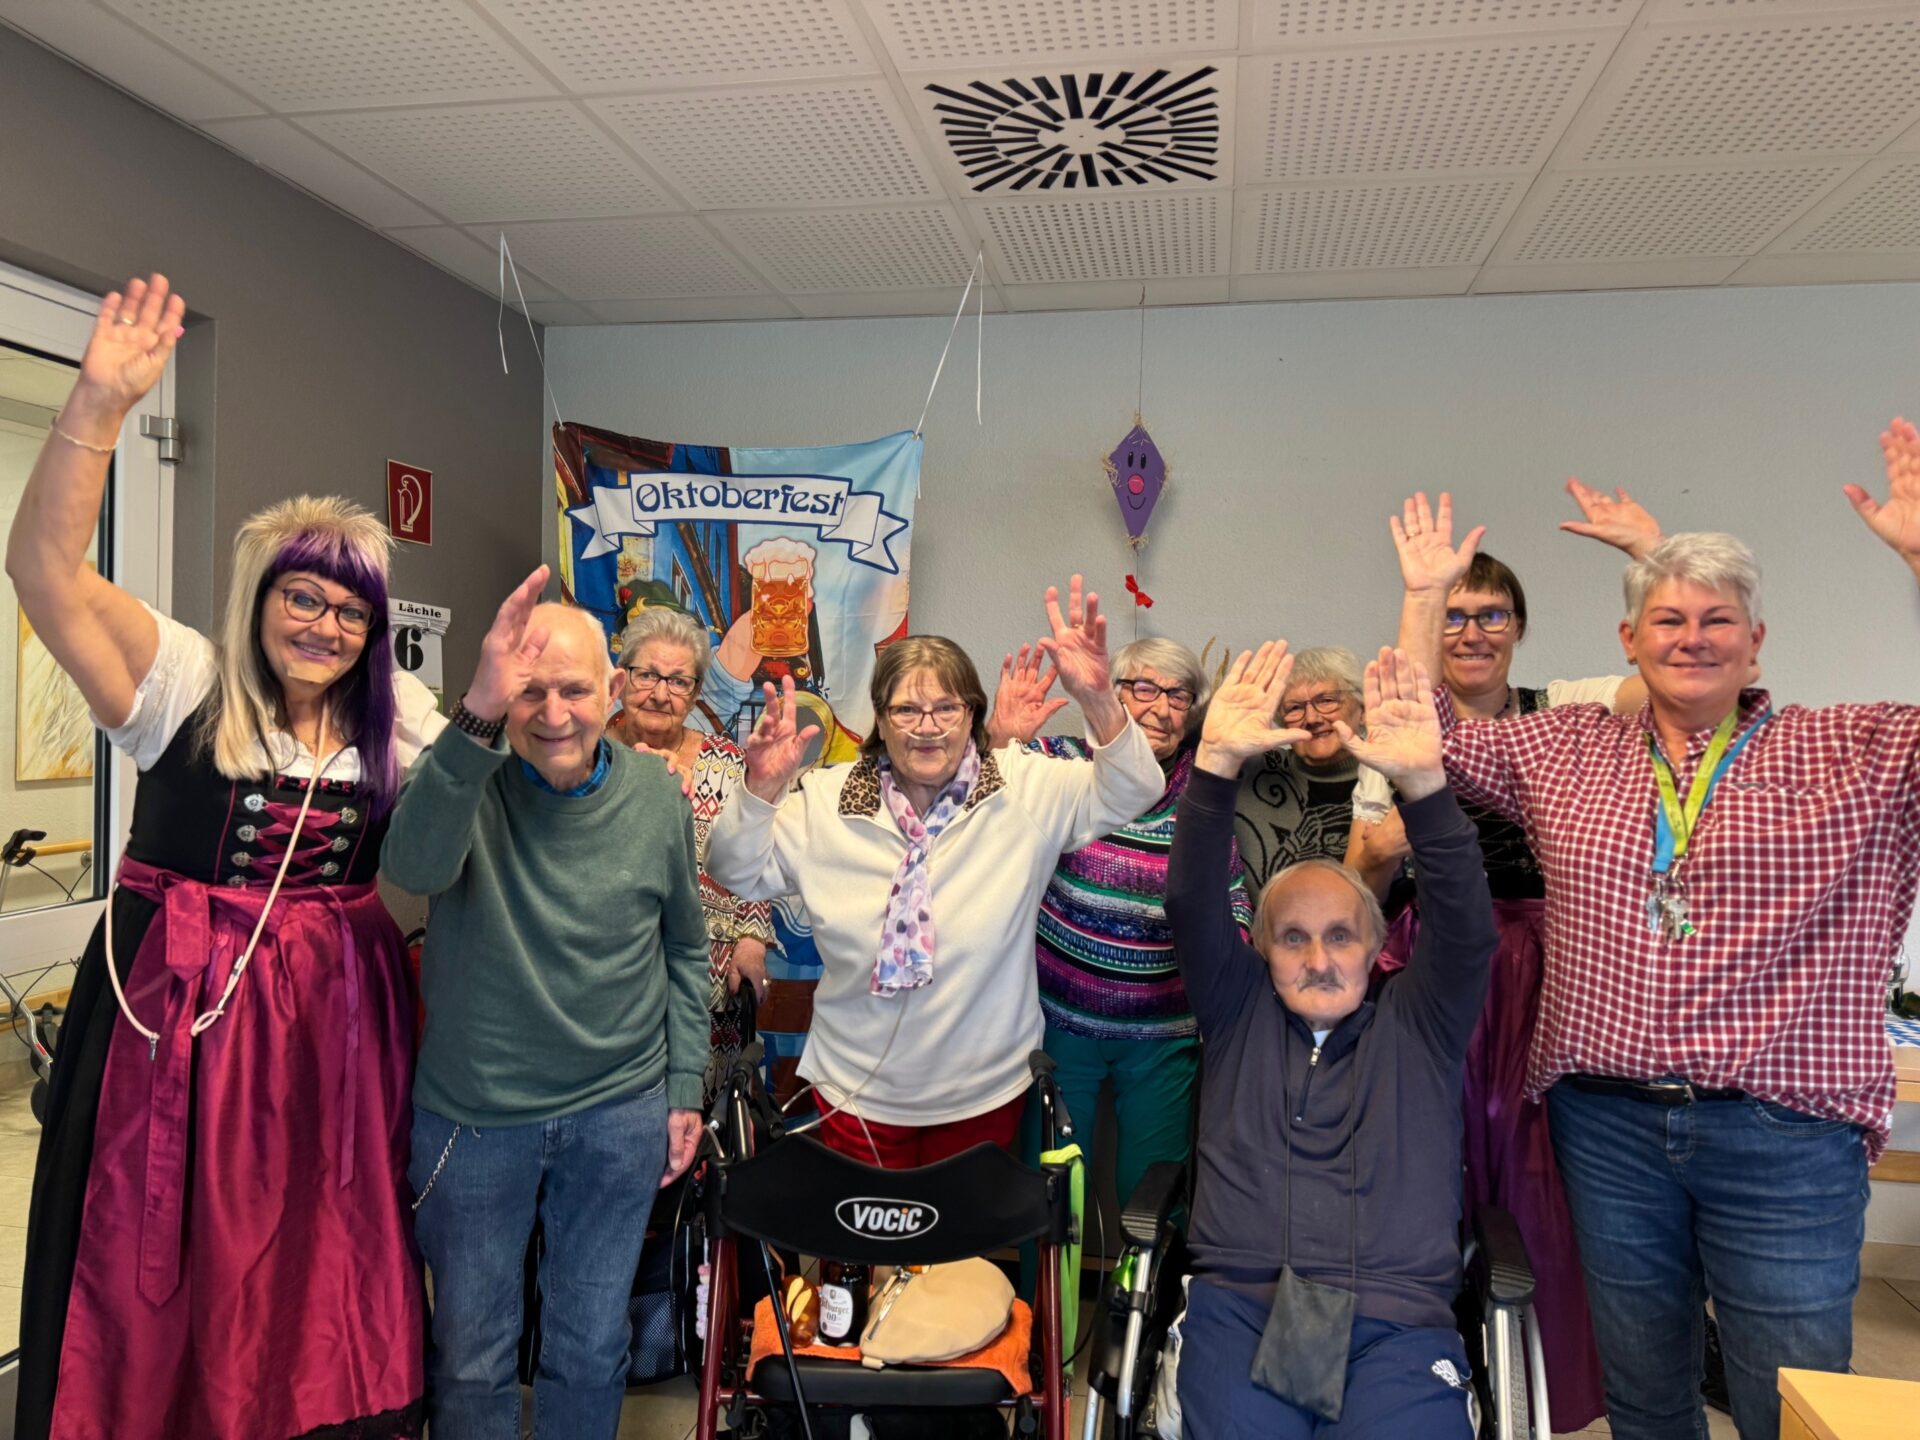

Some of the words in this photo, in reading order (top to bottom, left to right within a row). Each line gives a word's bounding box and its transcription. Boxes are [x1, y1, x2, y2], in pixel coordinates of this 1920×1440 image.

[636, 481, 844, 516] Oktoberfest
[398, 602, 442, 618] Lächle
[394, 627, 424, 671] 6
